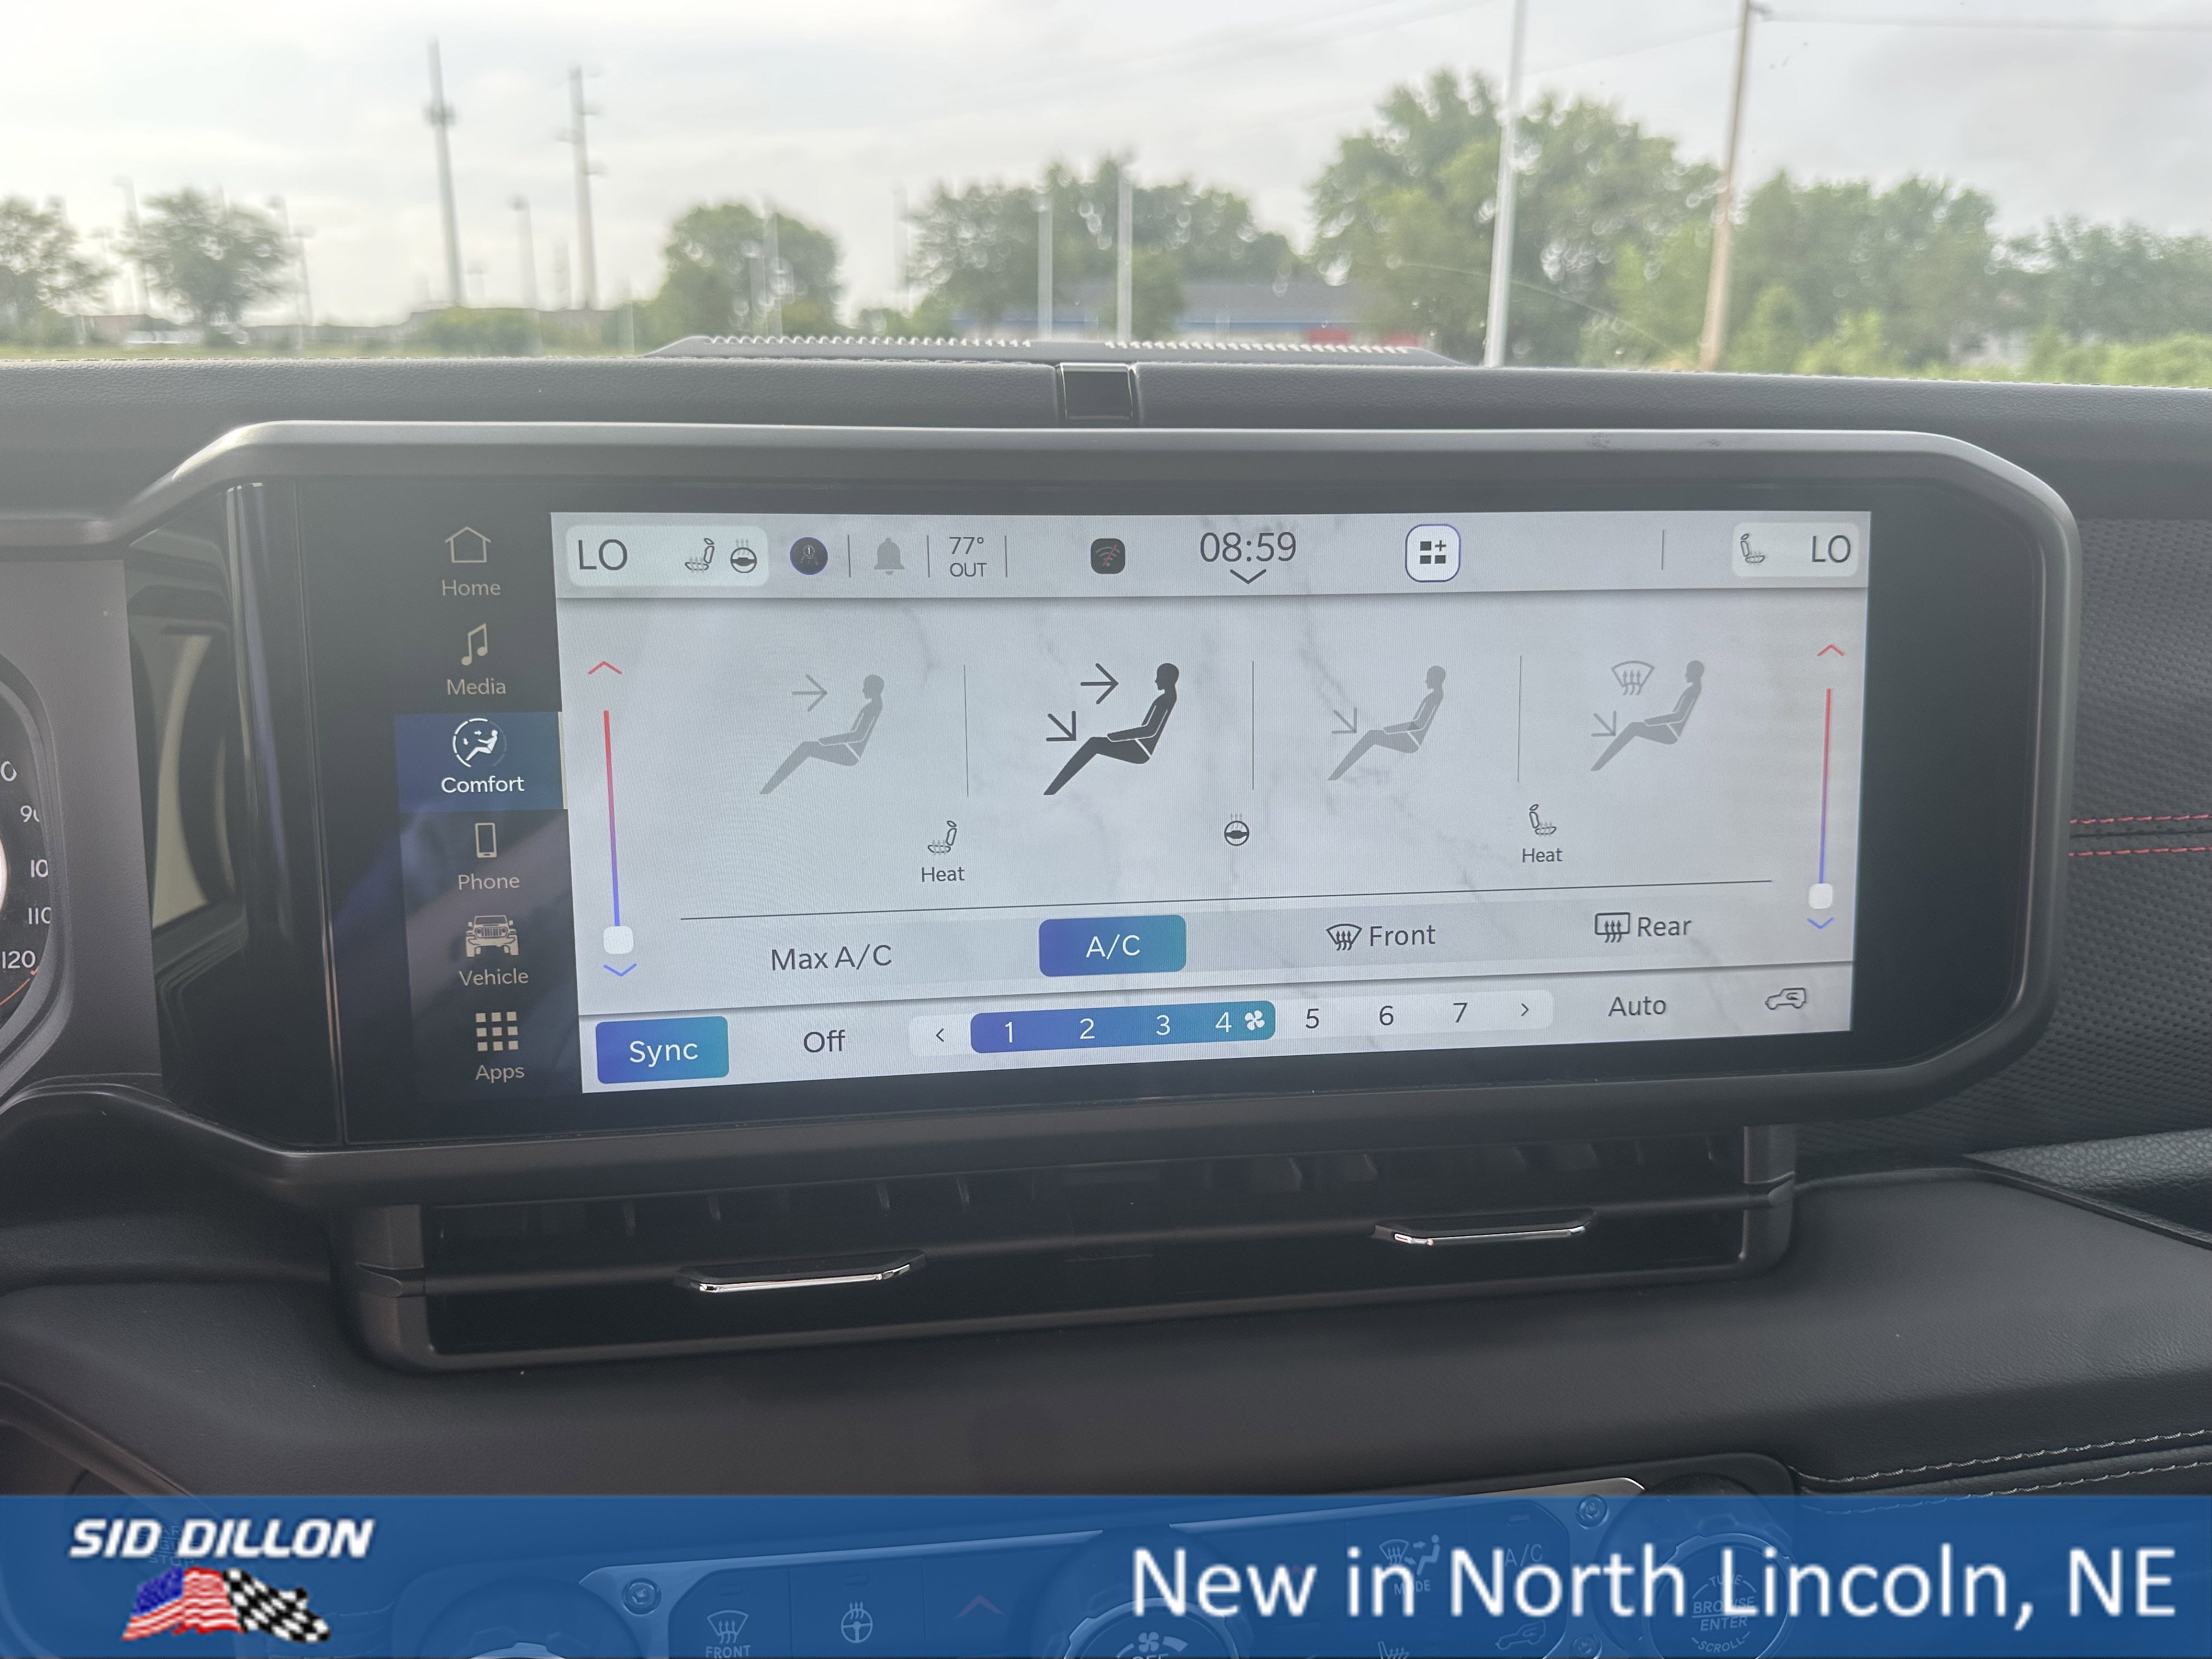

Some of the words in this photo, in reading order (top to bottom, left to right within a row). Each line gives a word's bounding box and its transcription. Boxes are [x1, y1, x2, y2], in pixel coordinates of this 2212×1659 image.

[578, 539, 628, 571] LO
[949, 537, 984, 555] 77°
[1200, 532, 1297, 562] 08:59
[1811, 535, 1851, 563] LO
[950, 562, 988, 577] OUT
[442, 580, 501, 596] Home
[447, 679, 506, 696] Media
[441, 775, 525, 793] Comfort
[1522, 848, 1562, 862] Heat
[458, 873, 520, 890] Phone
[921, 866, 966, 882] Heat
[1370, 925, 1436, 947] Front
[1637, 916, 1692, 937] Rear
[1086, 934, 1141, 960] A/C
[2, 950, 36, 969] 120
[771, 948, 828, 971] Max
[834, 944, 892, 970] A/C
[459, 968, 529, 986] Vehicle
[1607, 995, 1667, 1017] Auto
[1005, 1022, 1014, 1043] 1
[1079, 1018, 1095, 1040] 2
[1156, 1014, 1170, 1036] 3
[1215, 1012, 1232, 1033] 4
[1305, 1008, 1319, 1029] 5
[1379, 1005, 1393, 1026] 6
[1453, 1002, 1468, 1023] 7
[803, 1029, 846, 1053] Off
[629, 1040, 699, 1067] Sync
[475, 1064, 525, 1083] Apps
[1504, 1543, 1544, 1568] A/C
[1393, 1578, 1431, 1596] MDE
[1692, 1595, 1755, 1615] BROSE
[1700, 1616, 1748, 1631] ENTER
[705, 1645, 752, 1658] FRONT
[1697, 1637, 1746, 1654] SCROLL
